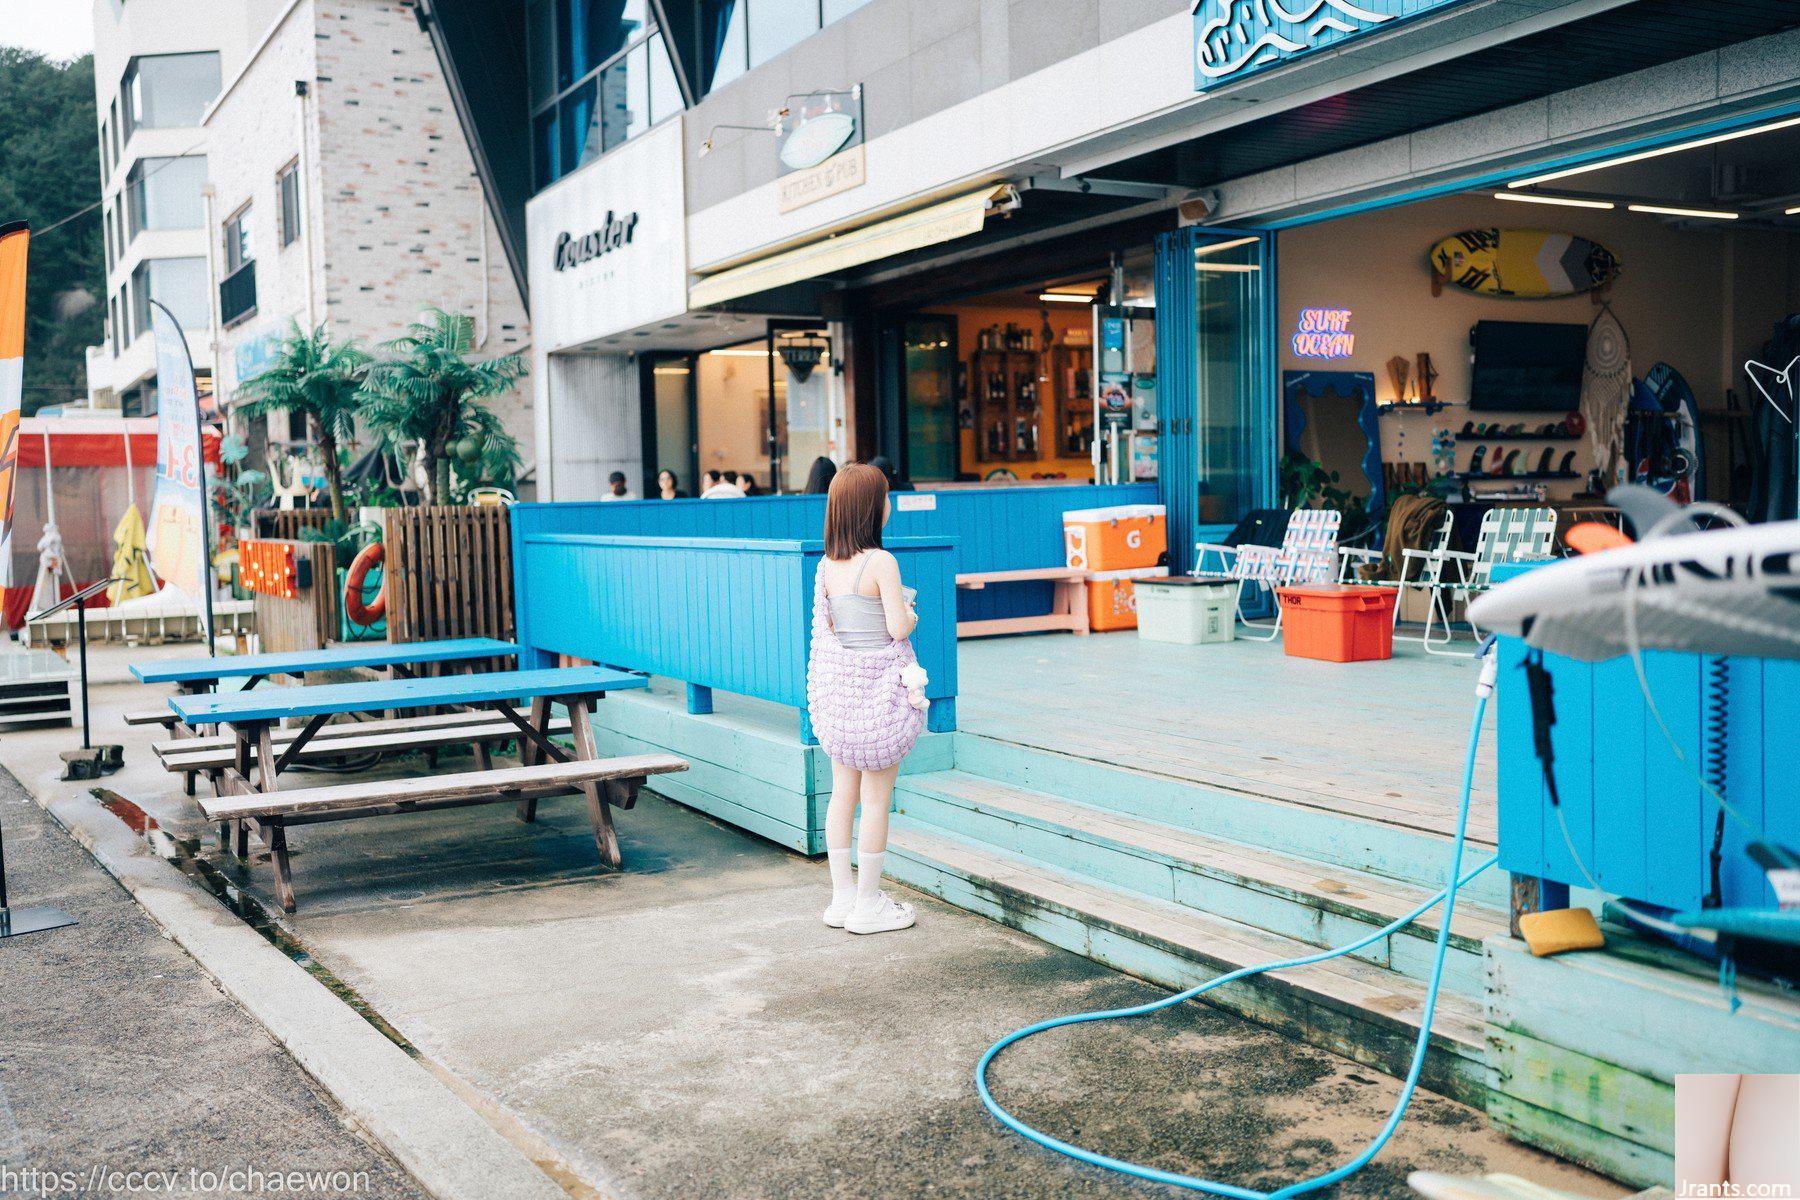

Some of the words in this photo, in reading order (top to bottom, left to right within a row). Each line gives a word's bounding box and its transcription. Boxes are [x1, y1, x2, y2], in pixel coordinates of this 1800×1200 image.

[1299, 308, 1352, 332] SURF
[1294, 332, 1355, 358] OCEAN
[1126, 530, 1141, 549] G
[1283, 595, 1302, 605] THOR
